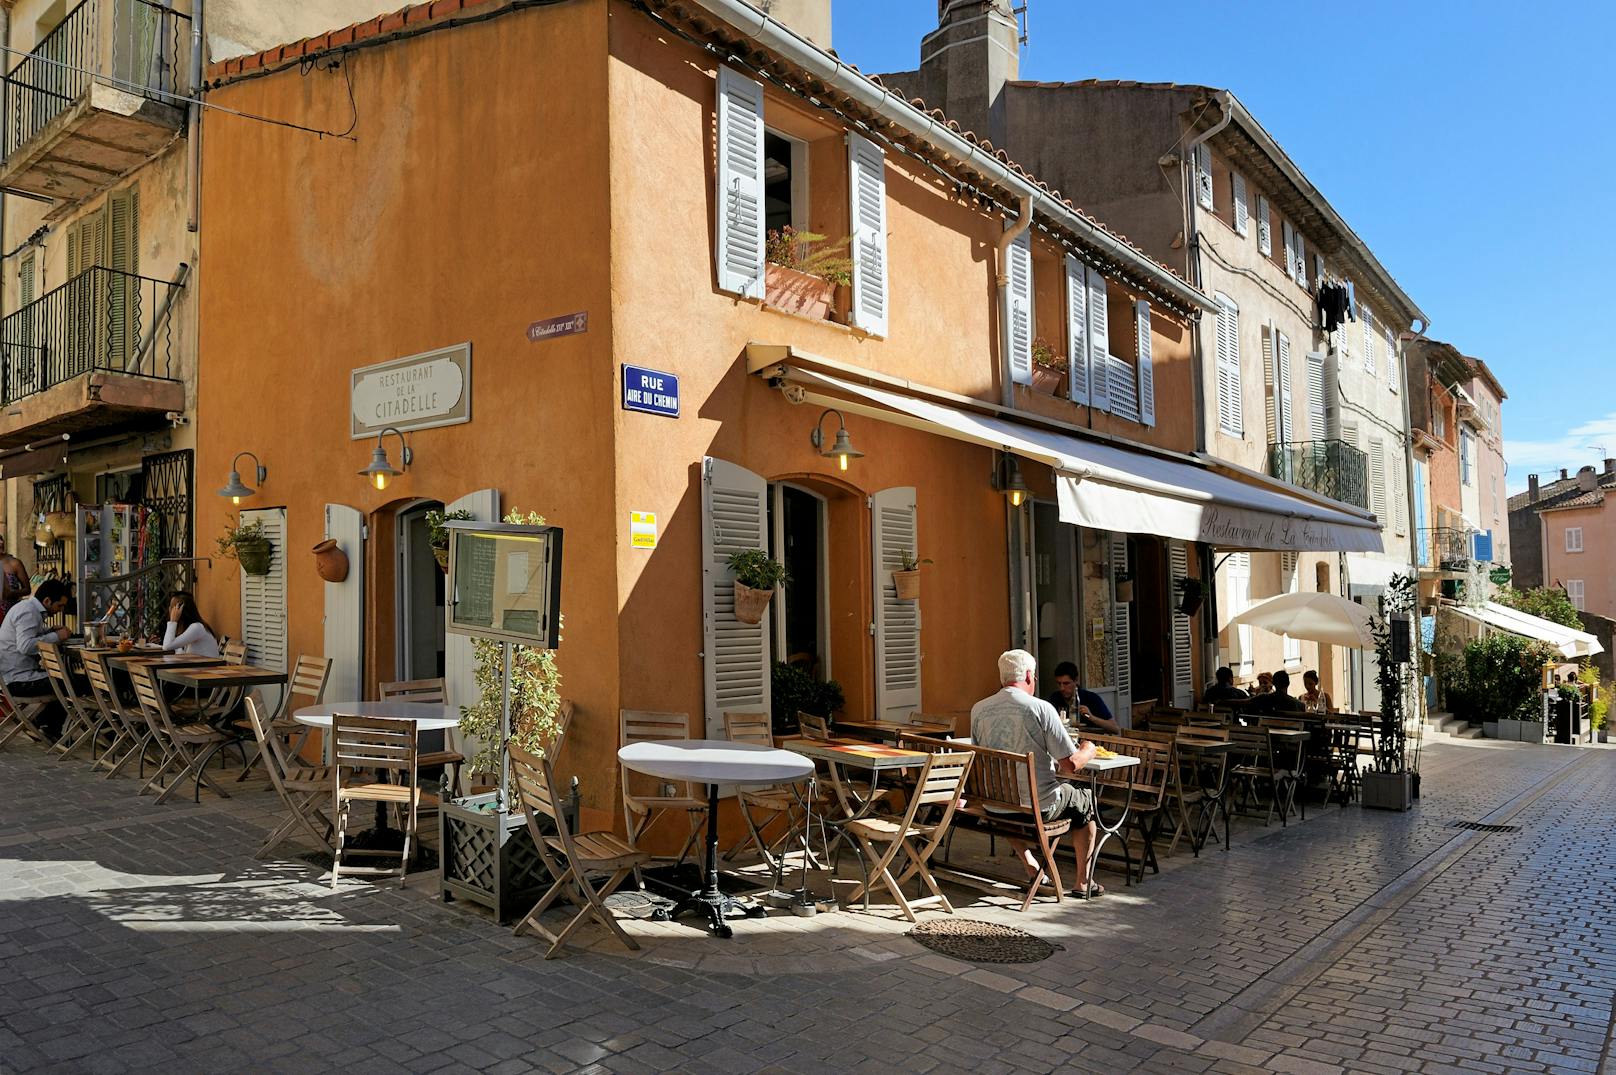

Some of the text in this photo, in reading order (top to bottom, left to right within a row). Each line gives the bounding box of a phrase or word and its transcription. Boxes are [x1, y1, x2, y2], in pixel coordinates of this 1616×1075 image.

[379, 365, 433, 388] RESTAURANT
[641, 374, 664, 391] RUE
[396, 384, 415, 398] DE LA
[627, 388, 677, 410] AIRE DU CHEMIN
[376, 392, 437, 418] CITADELLE
[1203, 506, 1263, 542] Restaurant
[1264, 521, 1275, 543] de
